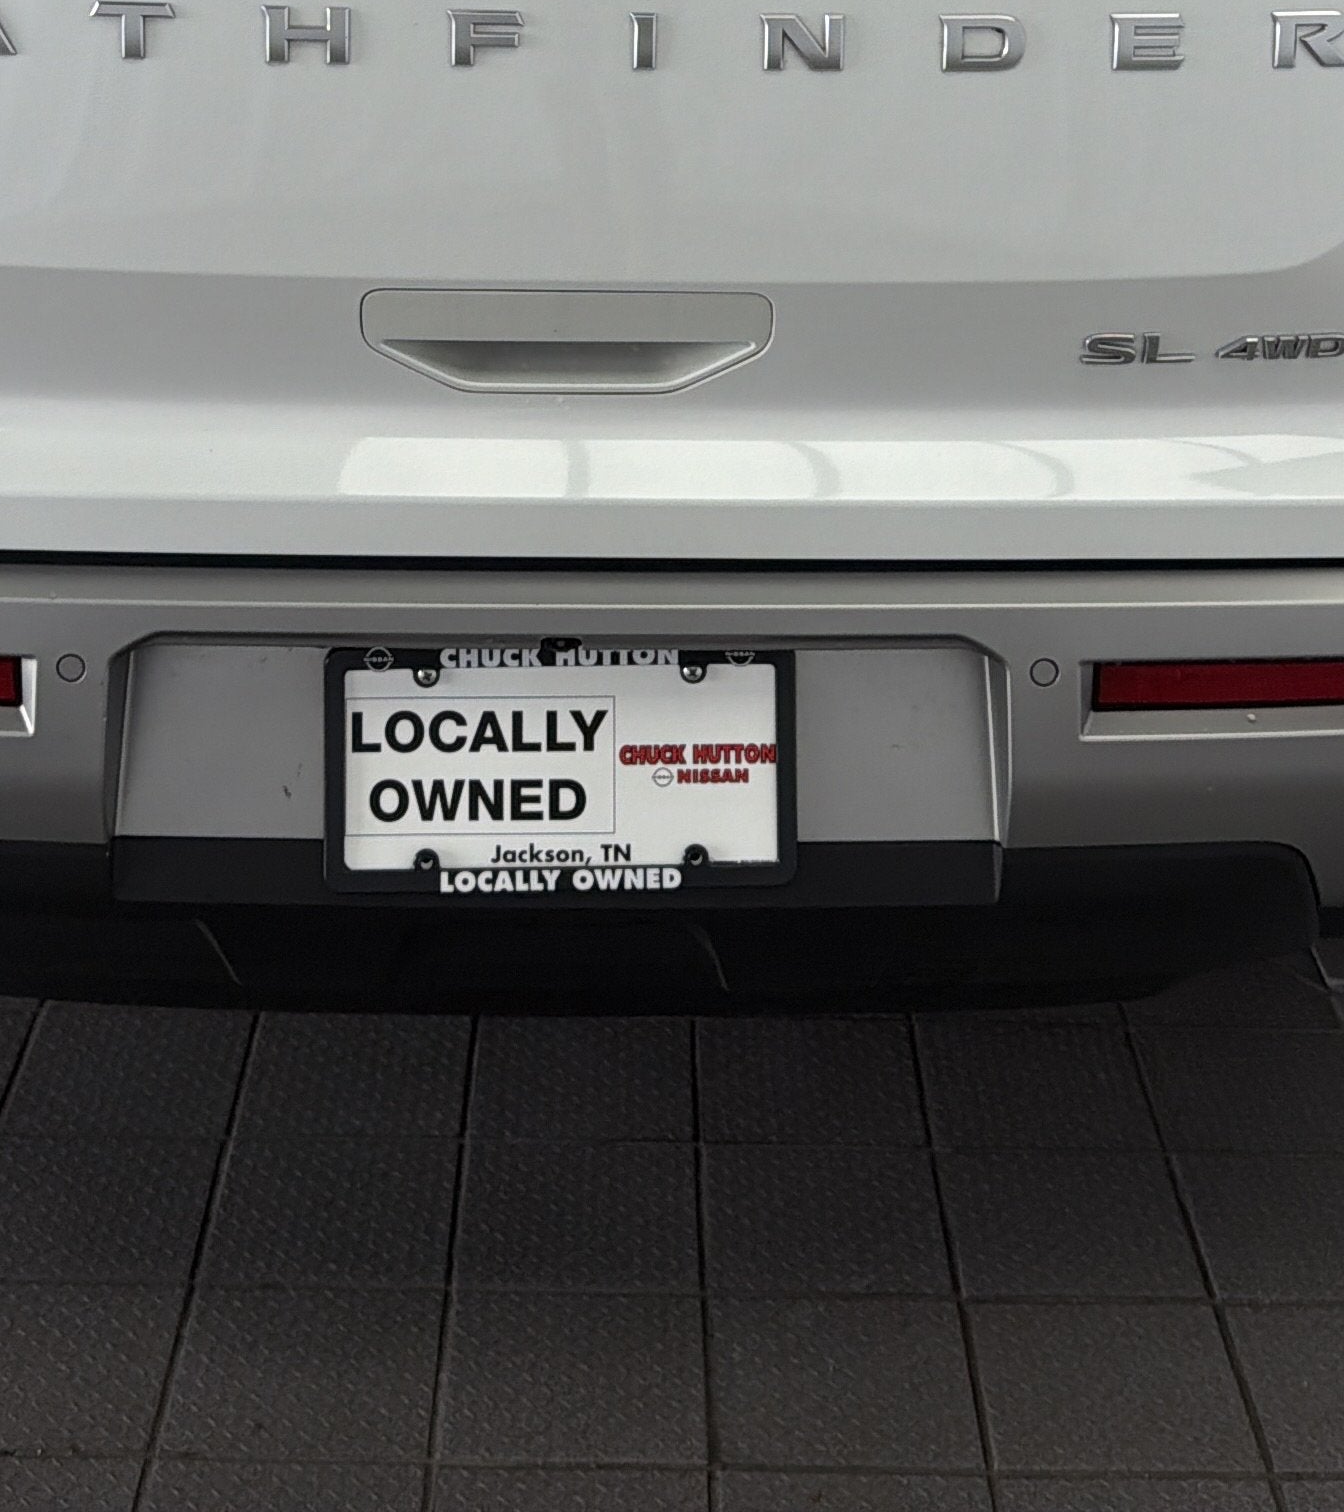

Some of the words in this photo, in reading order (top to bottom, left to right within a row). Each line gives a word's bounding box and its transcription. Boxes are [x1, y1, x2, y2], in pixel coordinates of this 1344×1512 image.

[1080, 332, 1195, 364] SL
[440, 648, 542, 668] CHUCK
[556, 648, 679, 666] HUTTON
[351, 709, 608, 753] LOCALLY
[619, 744, 687, 765] CHUCK
[693, 743, 778, 764] HUTTON
[677, 768, 749, 784] NISSAN
[369, 778, 587, 822] OWNED
[491, 843, 592, 865] Jackson,
[601, 843, 632, 862] TN
[440, 869, 561, 893] LOCALLY
[572, 868, 682, 890] OWNED
